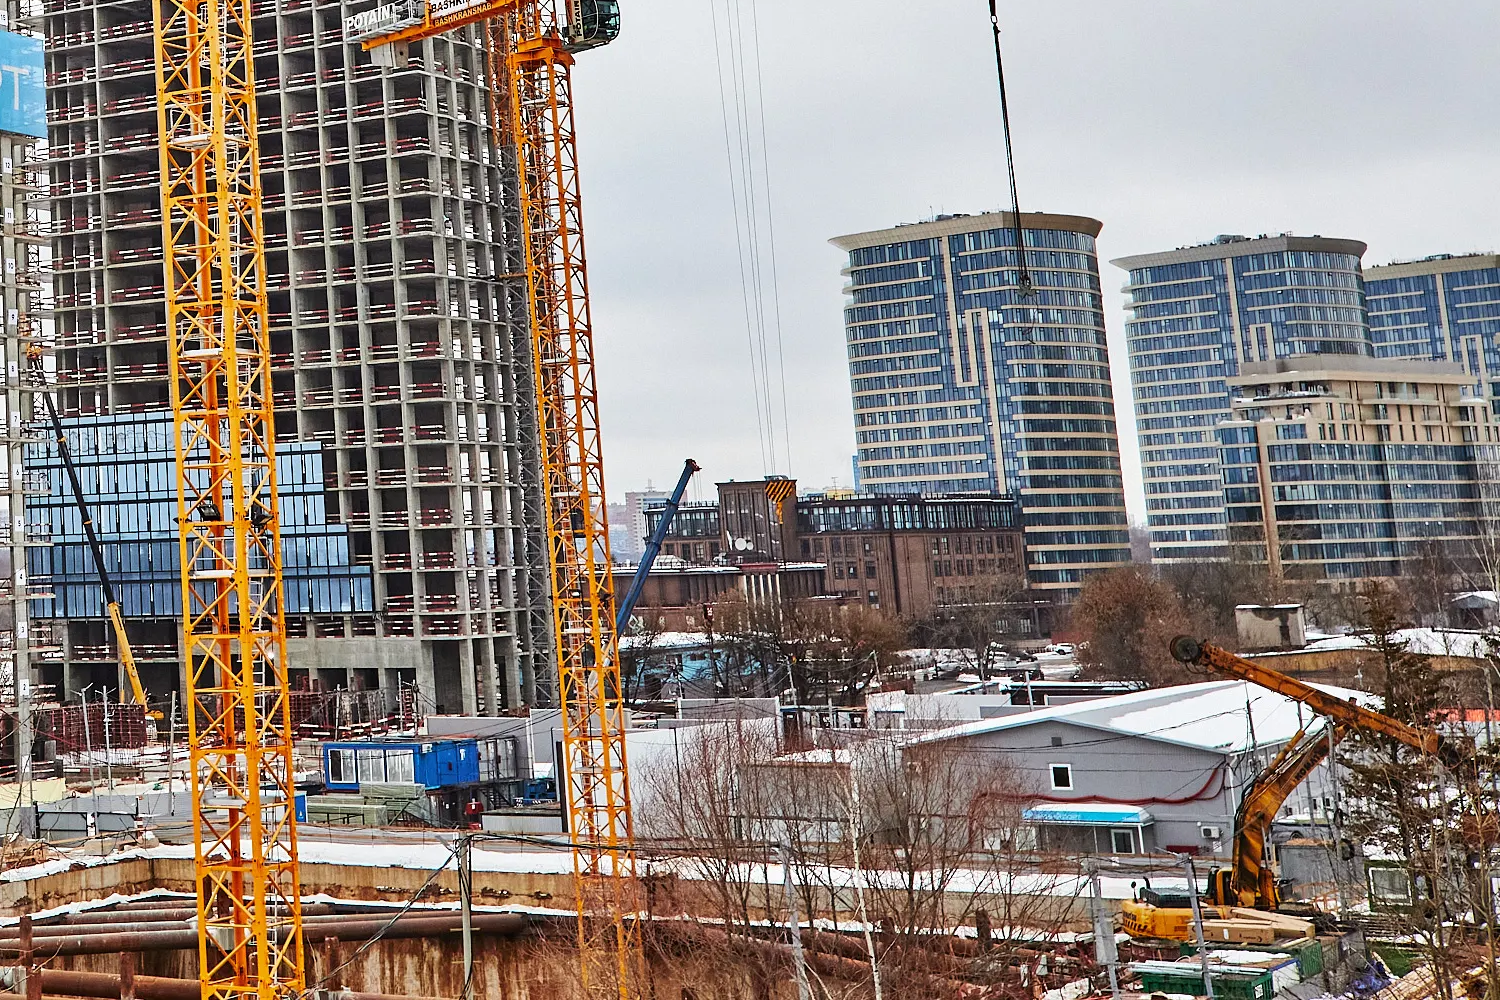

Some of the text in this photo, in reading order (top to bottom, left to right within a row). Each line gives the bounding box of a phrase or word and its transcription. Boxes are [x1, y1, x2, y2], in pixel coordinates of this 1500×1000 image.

[345, 3, 391, 32] POTAIN
[434, 2, 493, 26] BASHKRANSNAB
[573, 0, 583, 37] POTAIN
